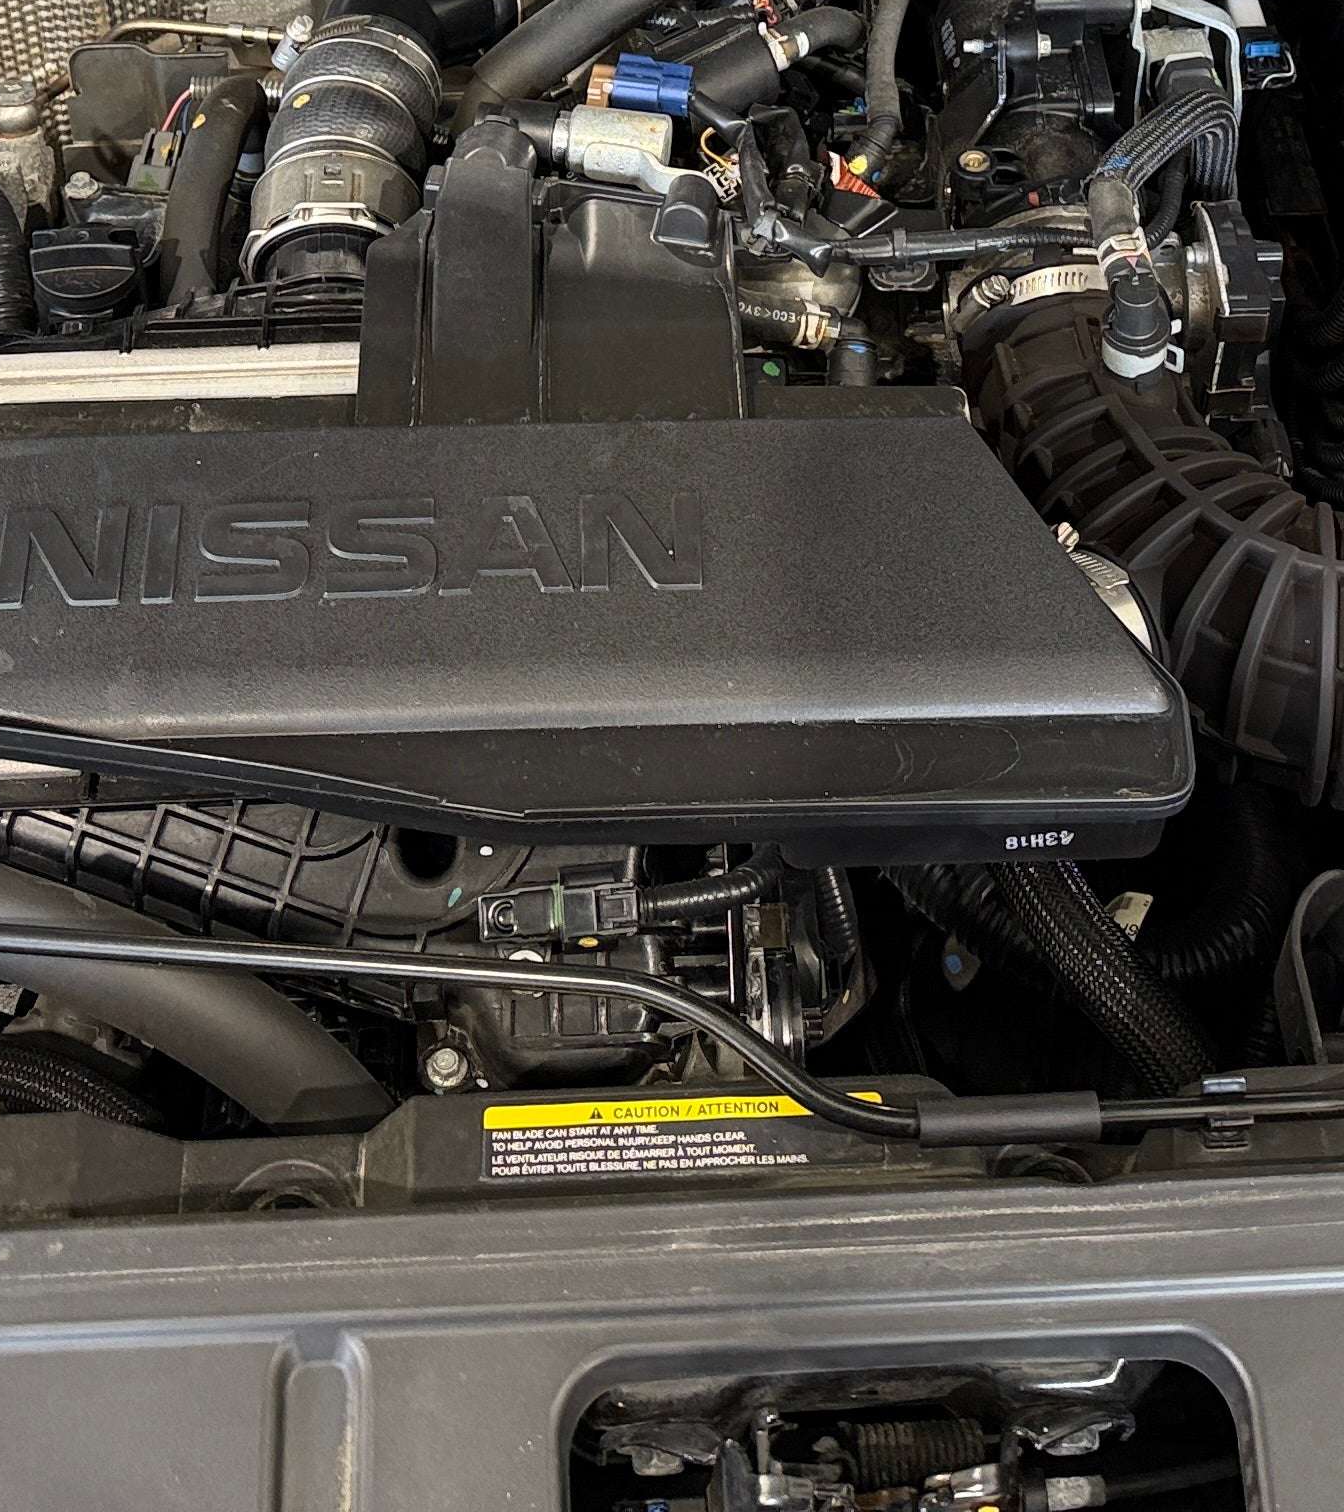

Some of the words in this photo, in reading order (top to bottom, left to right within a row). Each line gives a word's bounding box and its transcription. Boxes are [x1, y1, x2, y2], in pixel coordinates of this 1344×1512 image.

[613, 1105, 680, 1120] CAUTION
[697, 1101, 780, 1116] ATTENTION
[492, 1131, 511, 1140] FAN
[513, 1129, 544, 1139] BLADE
[546, 1128, 567, 1138] CAN
[569, 1127, 598, 1137] START
[600, 1126, 611, 1135] AT
[613, 1125, 633, 1135] ANY
[635, 1124, 659, 1134] TIME.
[492, 1143, 506, 1152] TO
[507, 1141, 533, 1151] HELP
[534, 1140, 563, 1150] AVOID
[565, 1138, 617, 1148] PERSONAL
[677, 1133, 712, 1144] HANDS
[713, 1131, 747, 1141] CLEAR.
[492, 1155, 505, 1165] LE
[506, 1153, 567, 1164] VENTILATEUR
[569, 1151, 606, 1162] RISQUE
[607, 1150, 621, 1159] DE
[622, 1148, 675, 1159] DÉMARRER
[676, 1145, 684, 1156] À
[686, 1145, 711, 1156] TOUT
[713, 1144, 757, 1154] MOMENT.
[492, 1166, 520, 1176] POUR
[522, 1163, 555, 1175] ÉVITER
[556, 1163, 587, 1173] TOUTE
[643, 1160, 657, 1170] NE
[659, 1159, 678, 1169] PAS
[679, 1159, 693, 1168] EN
[695, 1156, 755, 1167] APPROCHER
[756, 1155, 775, 1164] LES
[776, 1153, 809, 1164] MAINS.
